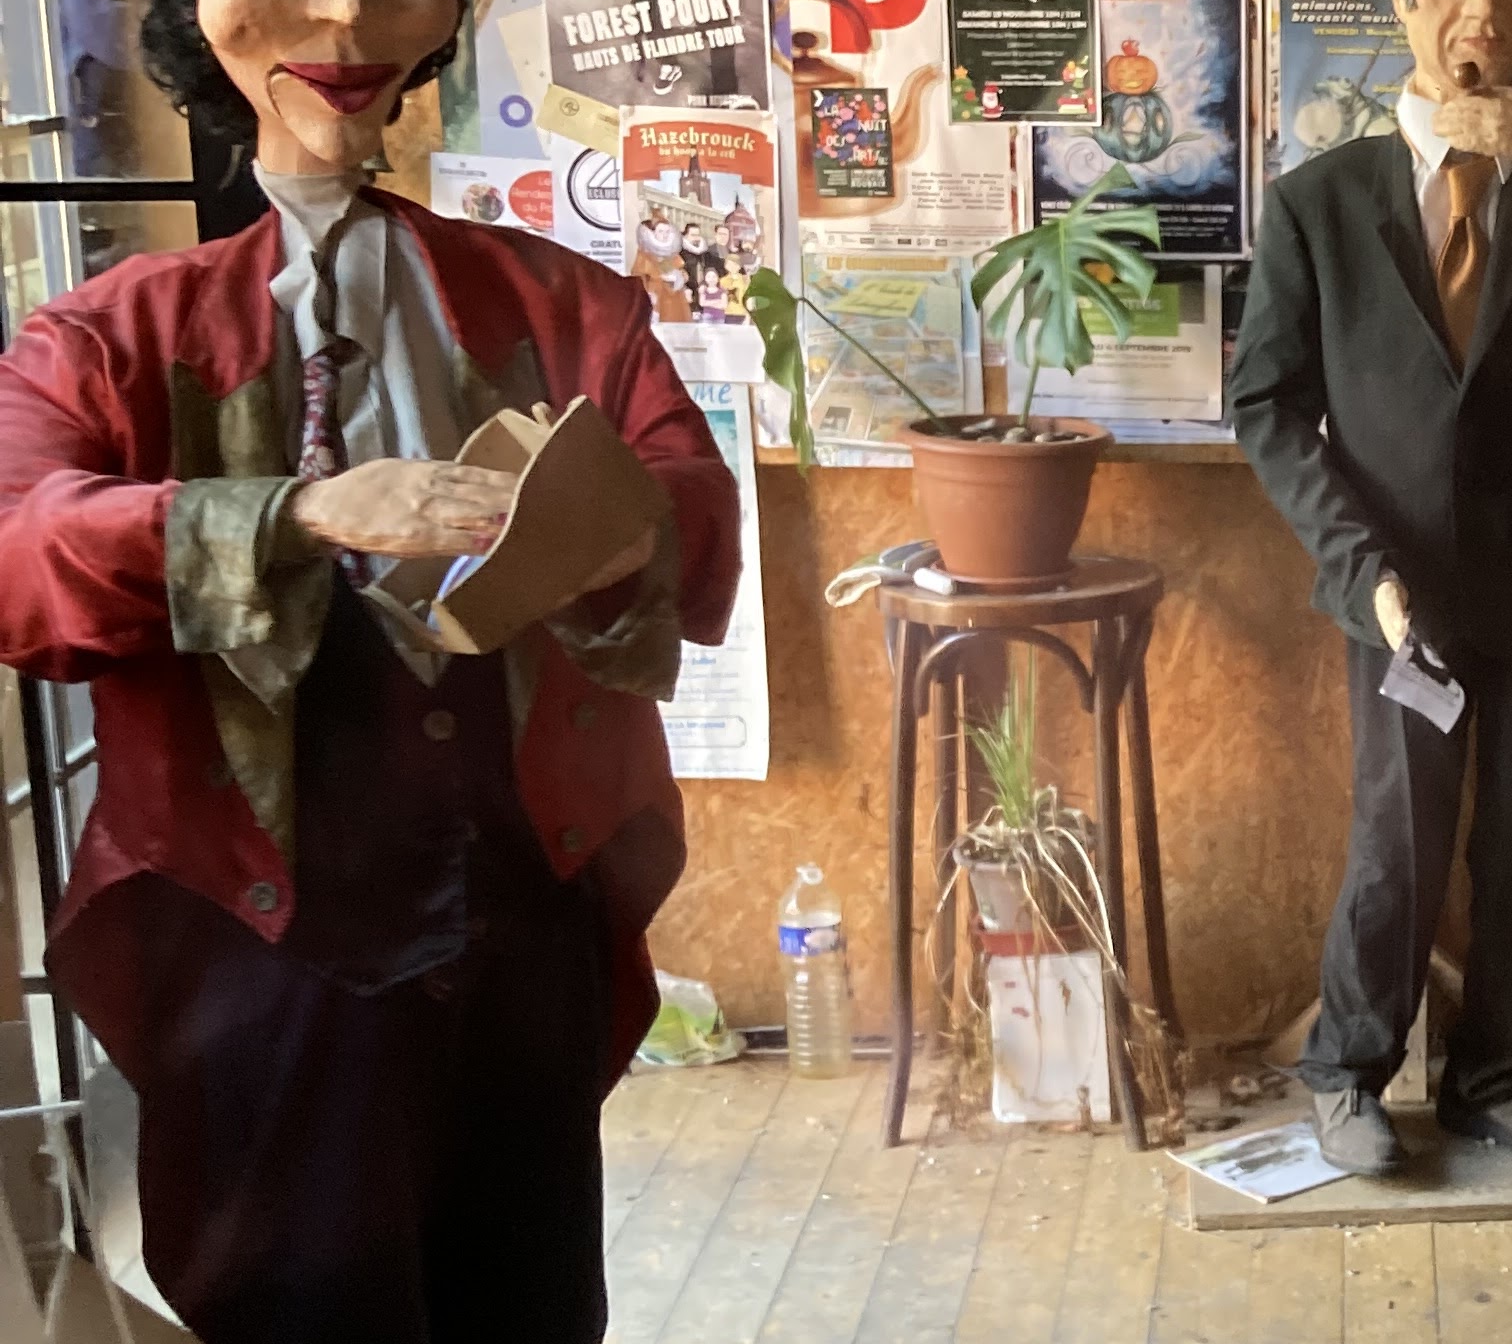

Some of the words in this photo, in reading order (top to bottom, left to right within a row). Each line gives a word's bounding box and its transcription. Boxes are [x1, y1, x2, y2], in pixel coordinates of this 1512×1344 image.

[1291, 1, 1376, 12] animations,
[1291, 12, 1354, 23] brocante
[563, 2, 651, 45] FOREST
[572, 45, 619, 72] HAUTS
[621, 43, 641, 62] DE
[645, 32, 704, 60] FLANDRE
[707, 26, 745, 49] TOUR
[640, 126, 756, 152] Hazebrouck
